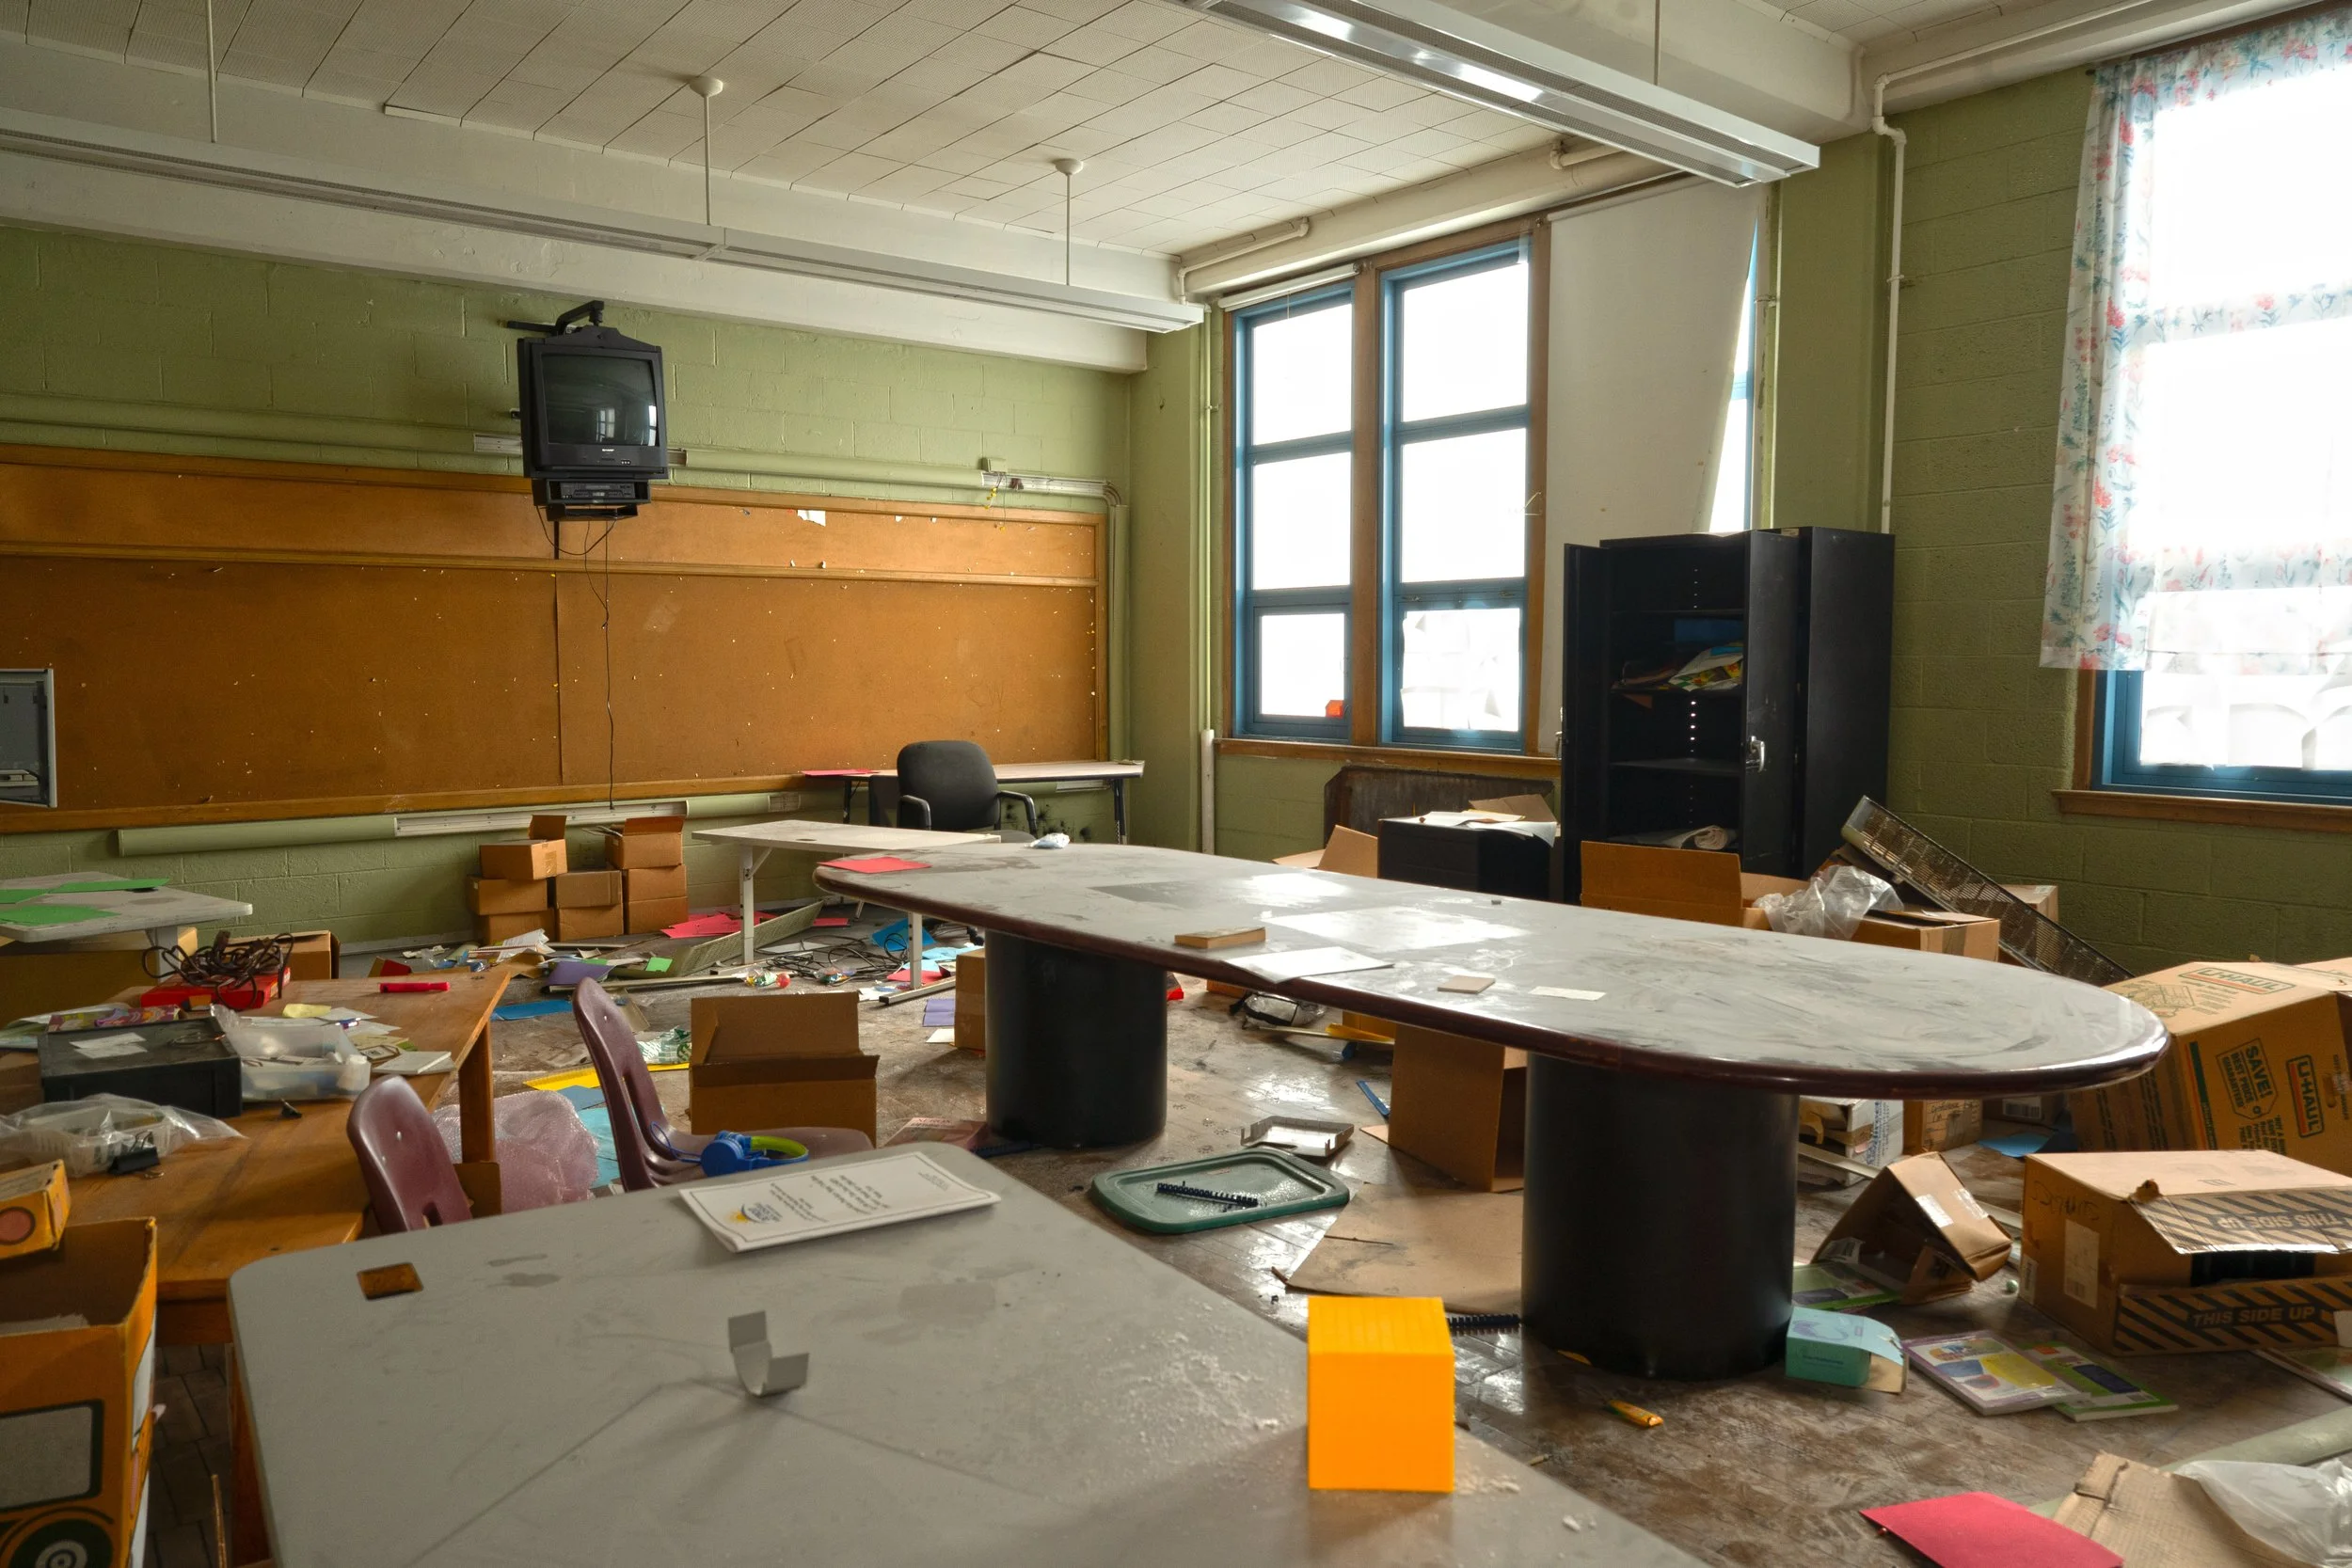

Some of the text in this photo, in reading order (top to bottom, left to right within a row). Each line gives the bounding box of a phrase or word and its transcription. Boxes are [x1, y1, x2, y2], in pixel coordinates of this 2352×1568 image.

[2230, 1052, 2255, 1103] BEST PRICE
[2246, 1045, 2274, 1099] SAVE!
[2217, 1212, 2343, 1228] THIS SIDE UP
[2193, 1306, 2316, 1327] THIS SIDE UP
